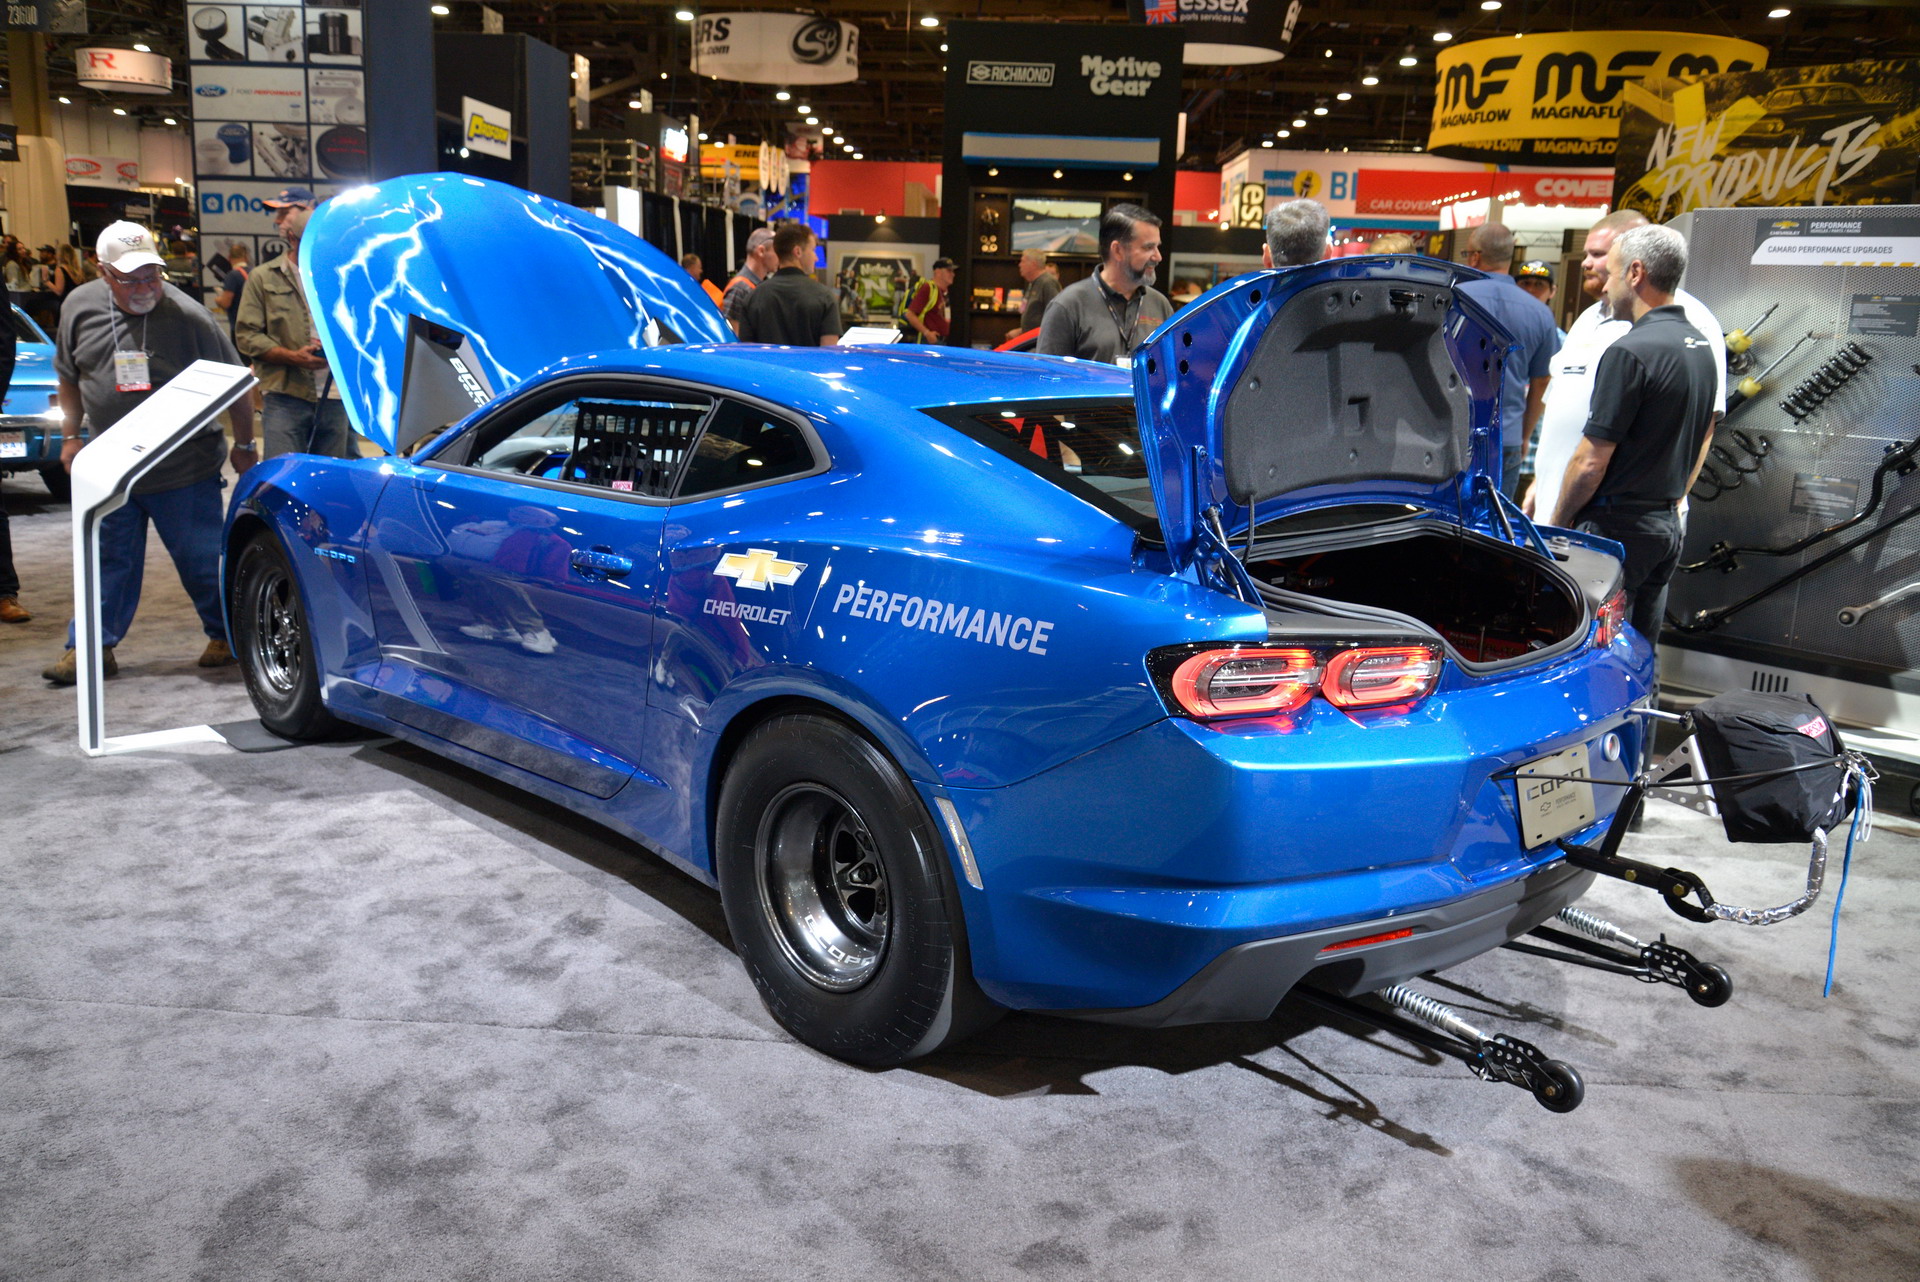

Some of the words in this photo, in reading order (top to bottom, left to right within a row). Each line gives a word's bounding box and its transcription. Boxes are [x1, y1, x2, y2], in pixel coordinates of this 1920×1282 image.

[1180, 14, 1197, 22] parts
[1200, 14, 1231, 22] services
[89, 52, 117, 69] R
[1080, 55, 1161, 78] Motive
[991, 66, 1050, 83] RICHMOND
[1090, 75, 1151, 96] Gear
[1440, 109, 1511, 130] MAGNAFLOW
[1646, 113, 1727, 172] NEW
[1654, 115, 1881, 222] PRODUCTS
[1369, 200, 1393, 210] CAR
[1810, 221, 1862, 229] PERFORMANCE
[1767, 245, 1797, 253] CAMARO
[1798, 245, 1851, 254] PERFORMANCE
[1853, 246, 1893, 254] UPGRADES
[703, 598, 791, 626] CHEVROLET
[832, 584, 1054, 656] PERFORMANCE
